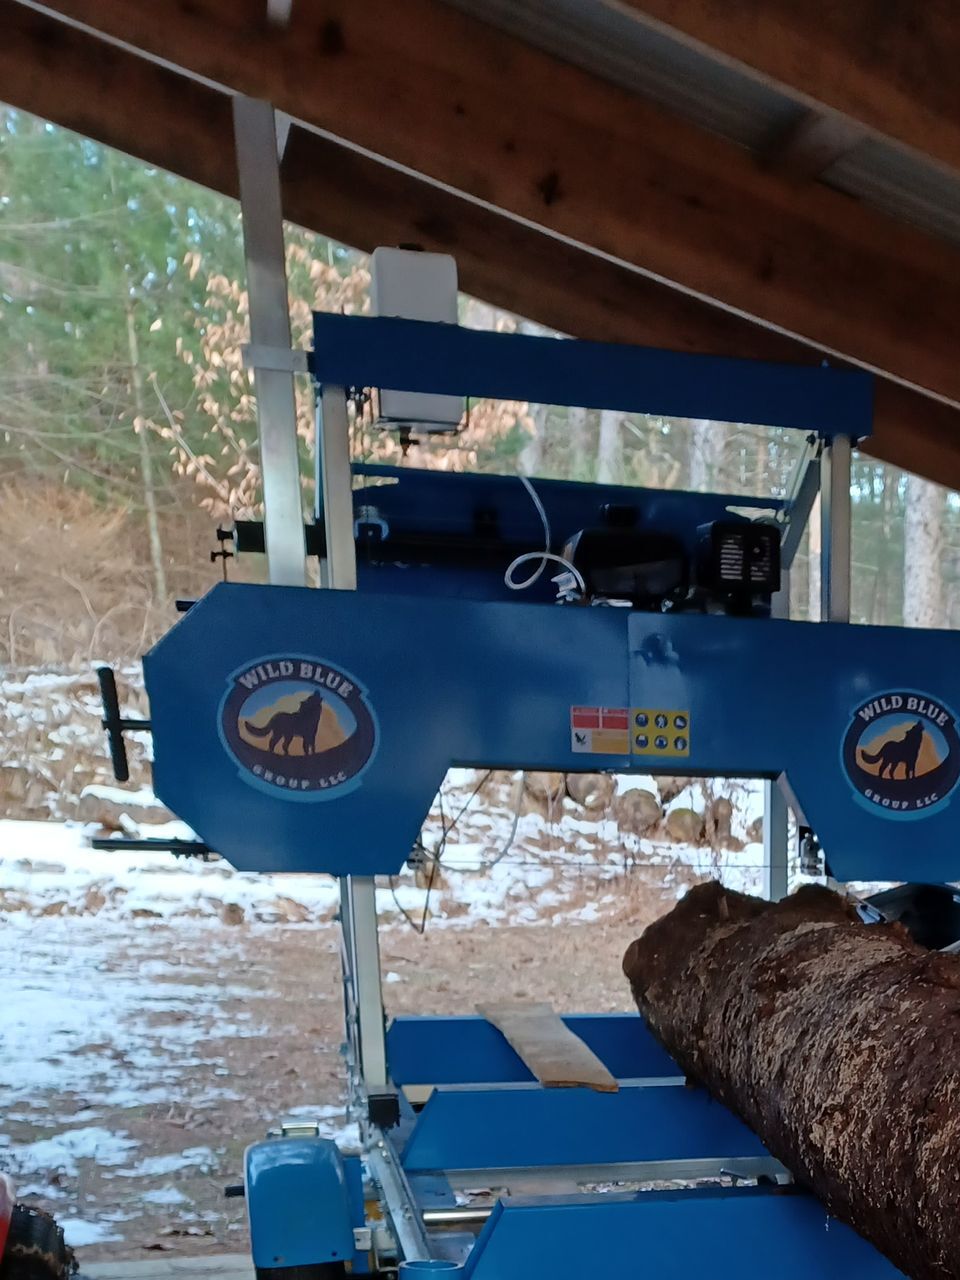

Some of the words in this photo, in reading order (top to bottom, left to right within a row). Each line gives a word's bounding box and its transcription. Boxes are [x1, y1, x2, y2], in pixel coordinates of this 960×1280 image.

[238, 661, 294, 689] WILD
[300, 662, 354, 699] BLUE
[858, 695, 903, 722] WILD
[906, 697, 949, 727] BLUE
[252, 764, 310, 790] GROUP
[319, 771, 347, 788] LLC
[864, 788, 909, 810] GROUP
[916, 792, 938, 808] LLC
